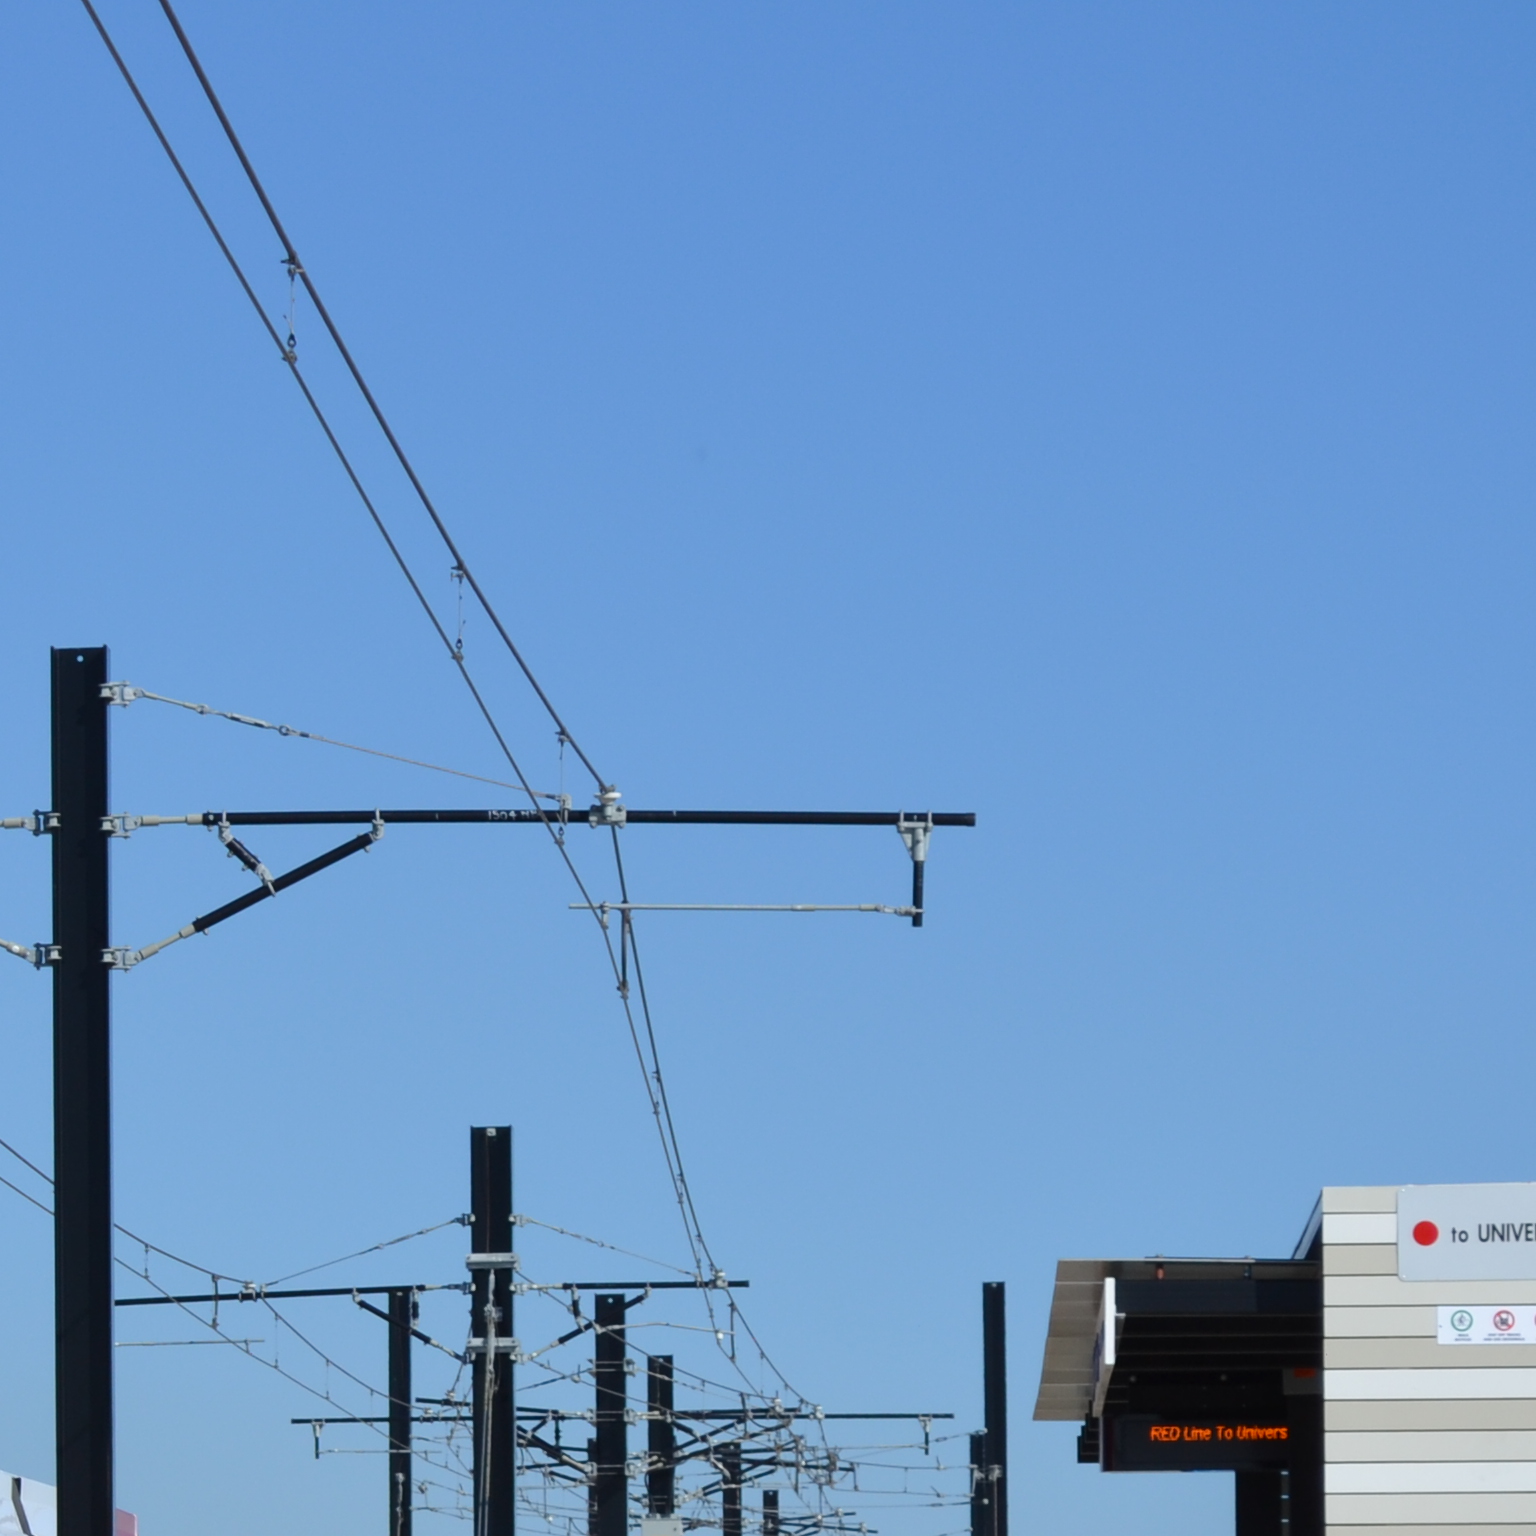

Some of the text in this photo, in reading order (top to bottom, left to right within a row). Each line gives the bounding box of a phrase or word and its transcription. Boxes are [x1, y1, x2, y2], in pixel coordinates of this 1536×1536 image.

[1451, 1222, 1536, 1243] to UNIVE
[1150, 1425, 1288, 1441] RED Line To Univers
